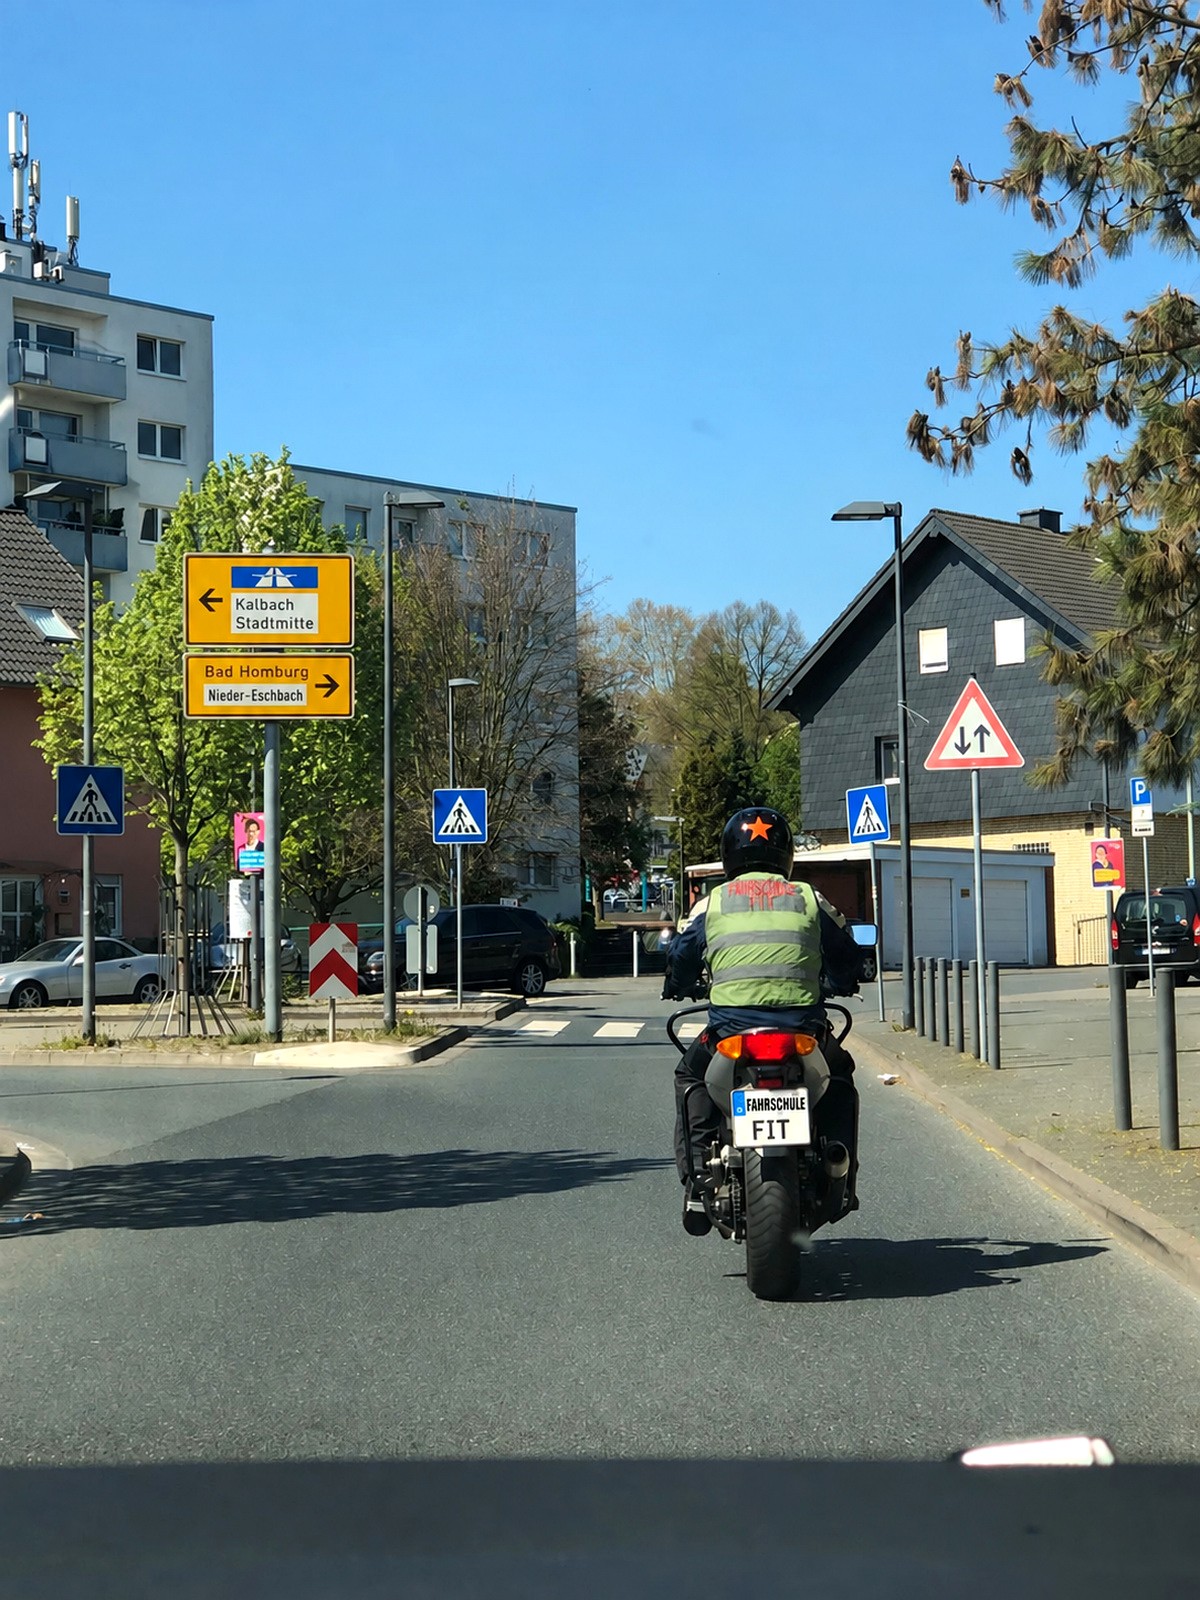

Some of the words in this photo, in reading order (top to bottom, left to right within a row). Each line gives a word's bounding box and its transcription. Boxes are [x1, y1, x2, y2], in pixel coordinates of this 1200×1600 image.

[235, 598, 294, 611] Kalbach
[236, 616, 314, 630] Stadtmitte
[205, 665, 233, 678] Bad
[240, 665, 309, 681] Homburg
[208, 688, 303, 702] Nieder-Eschbach
[1135, 781, 1146, 802] P
[746, 1097, 806, 1112] FAHRSCHULE
[752, 1119, 790, 1141] FIT
